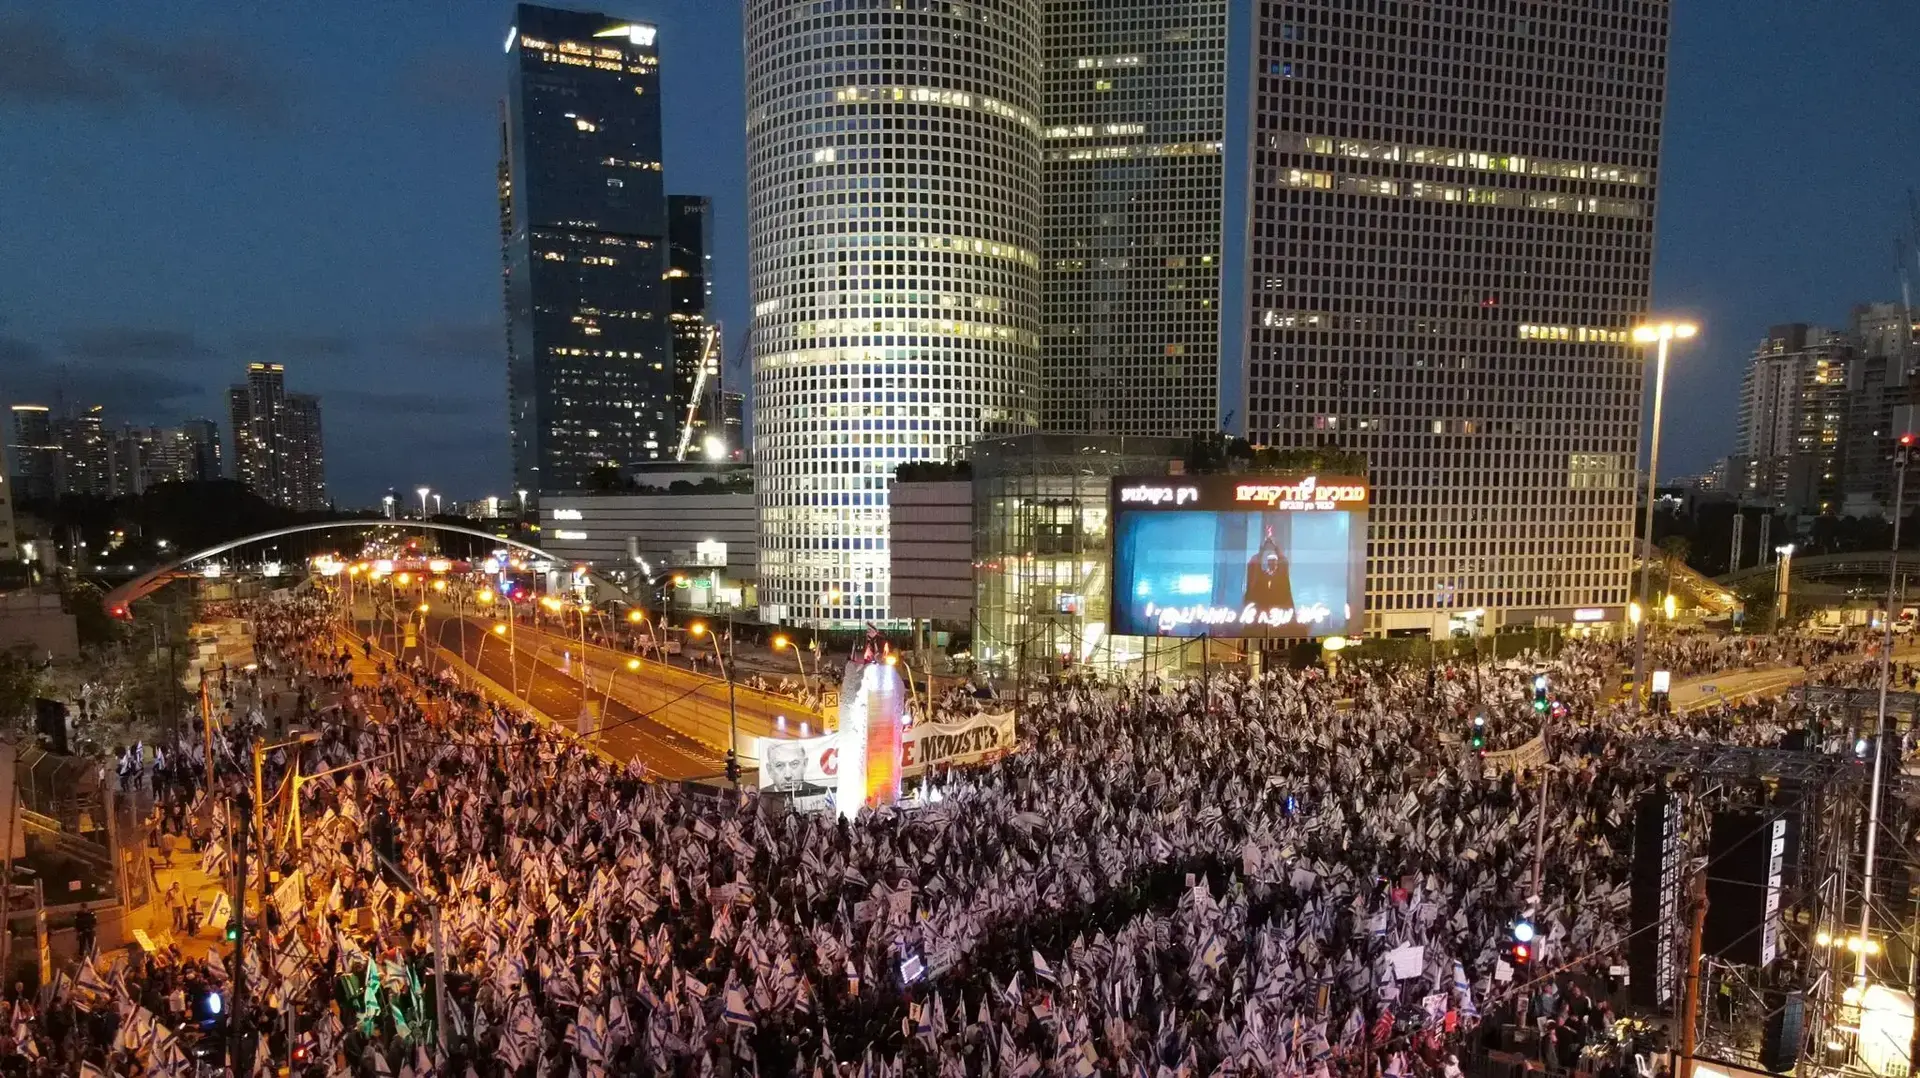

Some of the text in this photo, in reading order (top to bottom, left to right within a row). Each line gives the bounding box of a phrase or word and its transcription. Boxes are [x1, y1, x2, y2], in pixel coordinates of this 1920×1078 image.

[1177, 487, 1198, 505] רק
[1315, 486, 1365, 501] מבוכים
[919, 725, 999, 763] MINISTER
